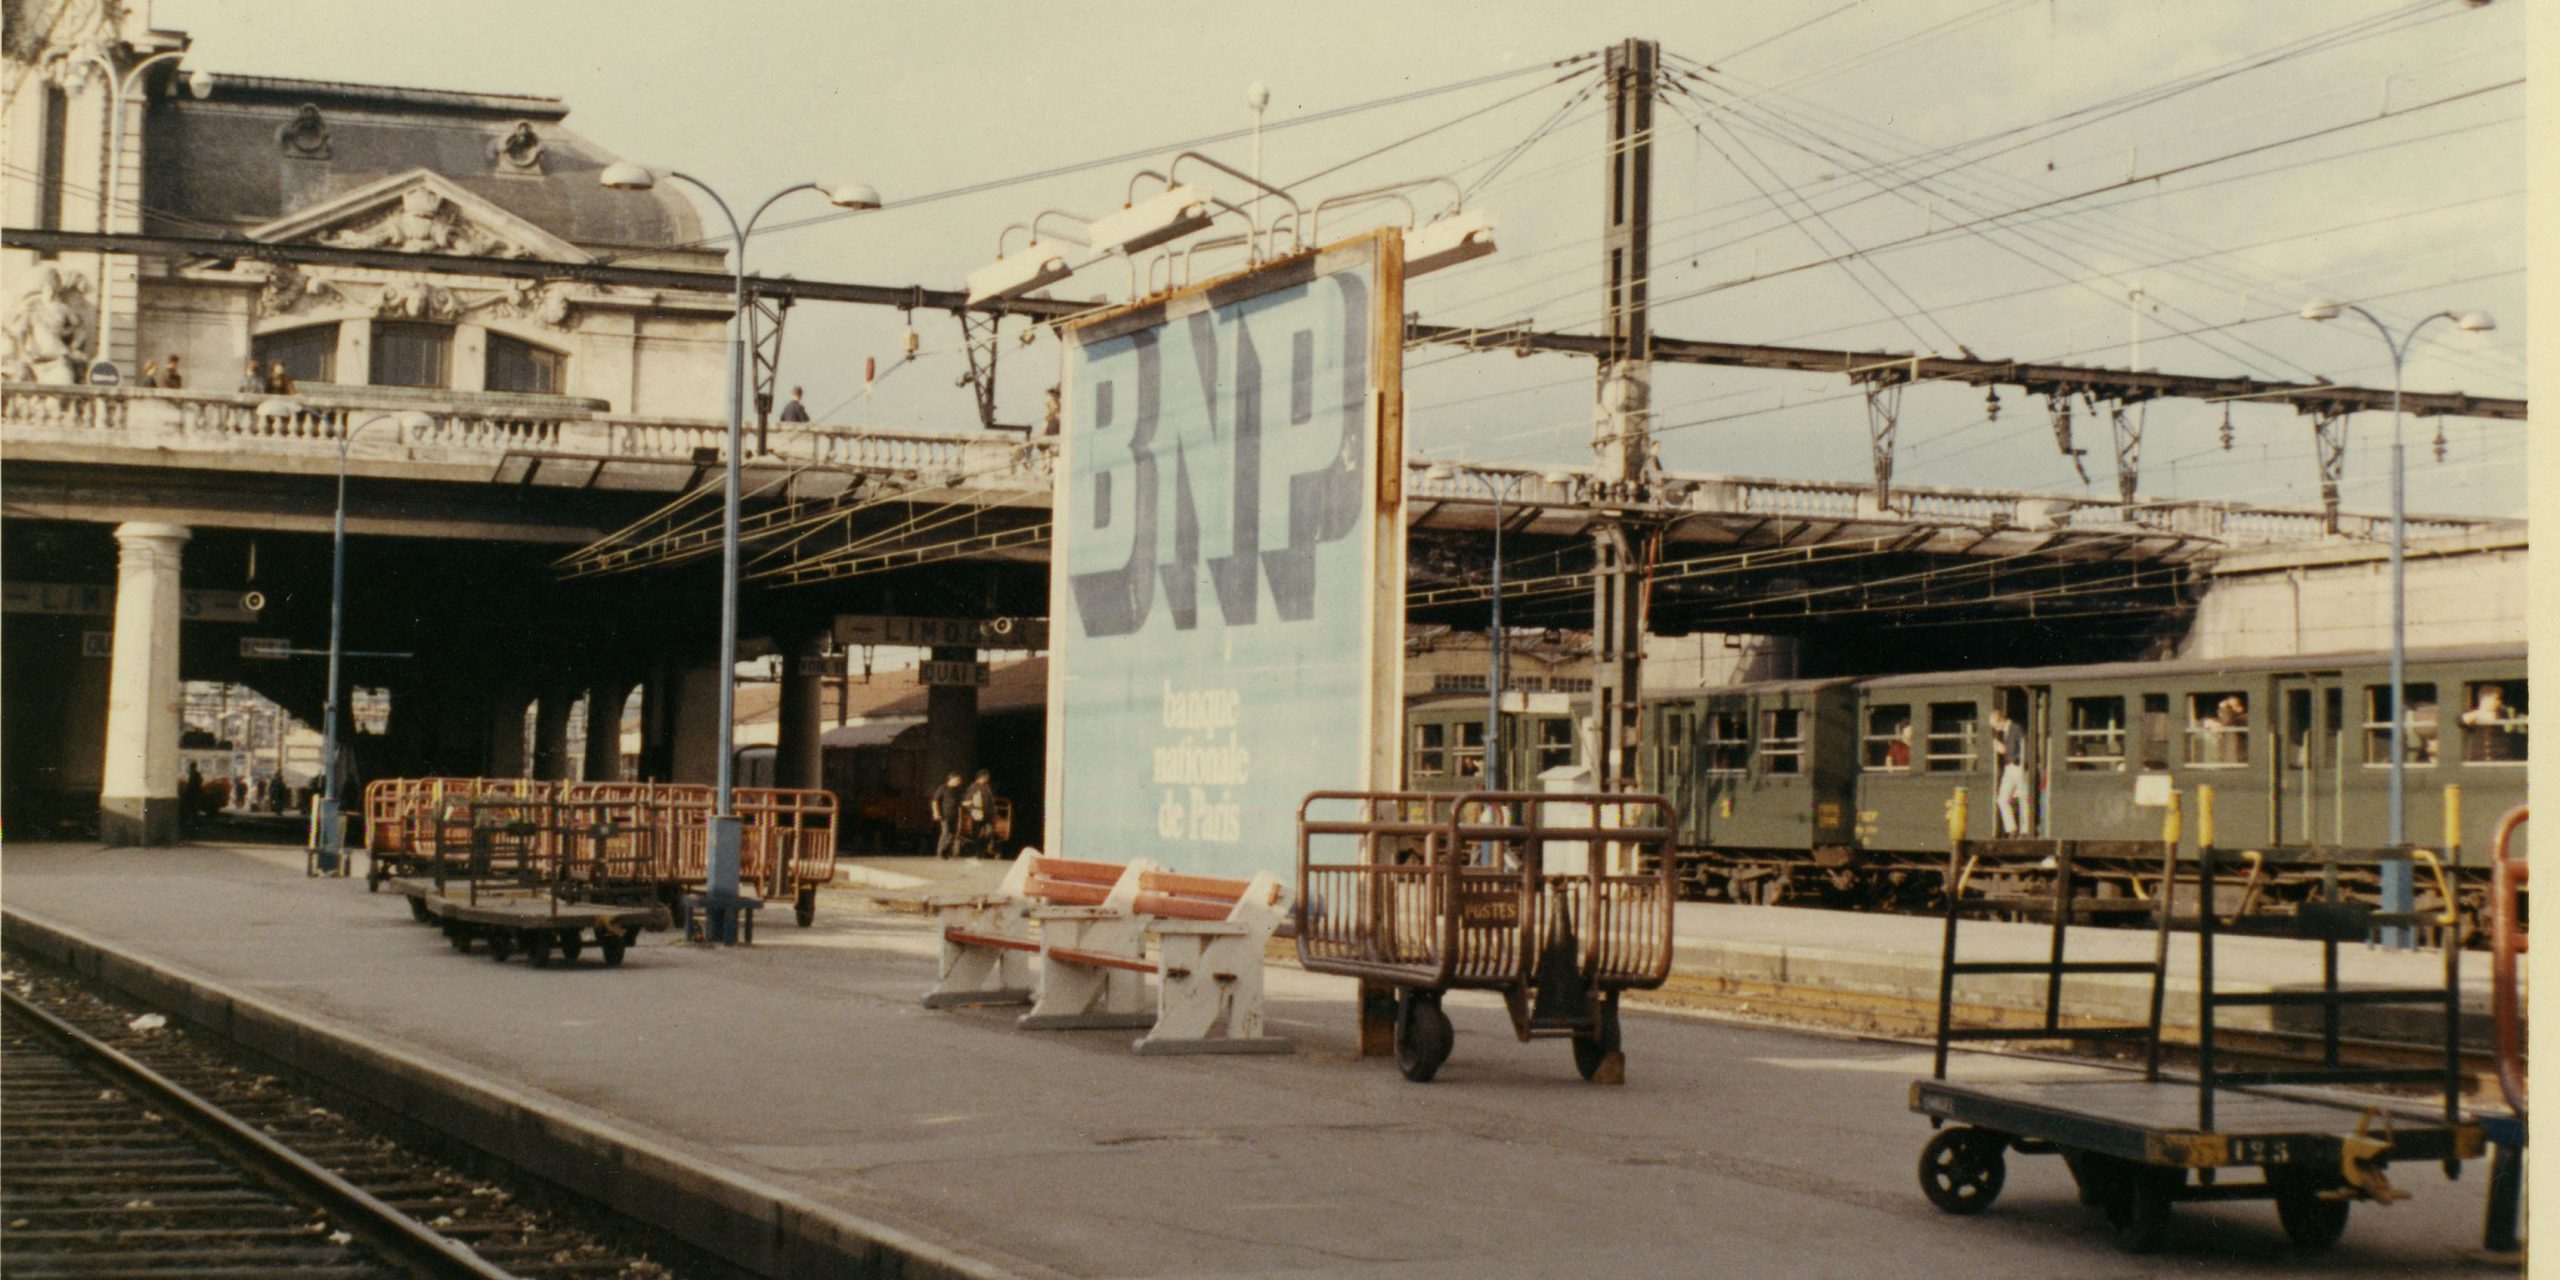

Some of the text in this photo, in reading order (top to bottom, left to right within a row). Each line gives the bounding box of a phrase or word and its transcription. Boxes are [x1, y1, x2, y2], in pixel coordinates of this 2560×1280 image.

[1069, 274, 1367, 636] BNP
[923, 662, 967, 683] QUAI
[1162, 679, 1240, 739] banque
[1152, 729, 1249, 784] nationale
[1158, 786, 1241, 842] de Paris
[1465, 902, 1517, 920] POSTES
